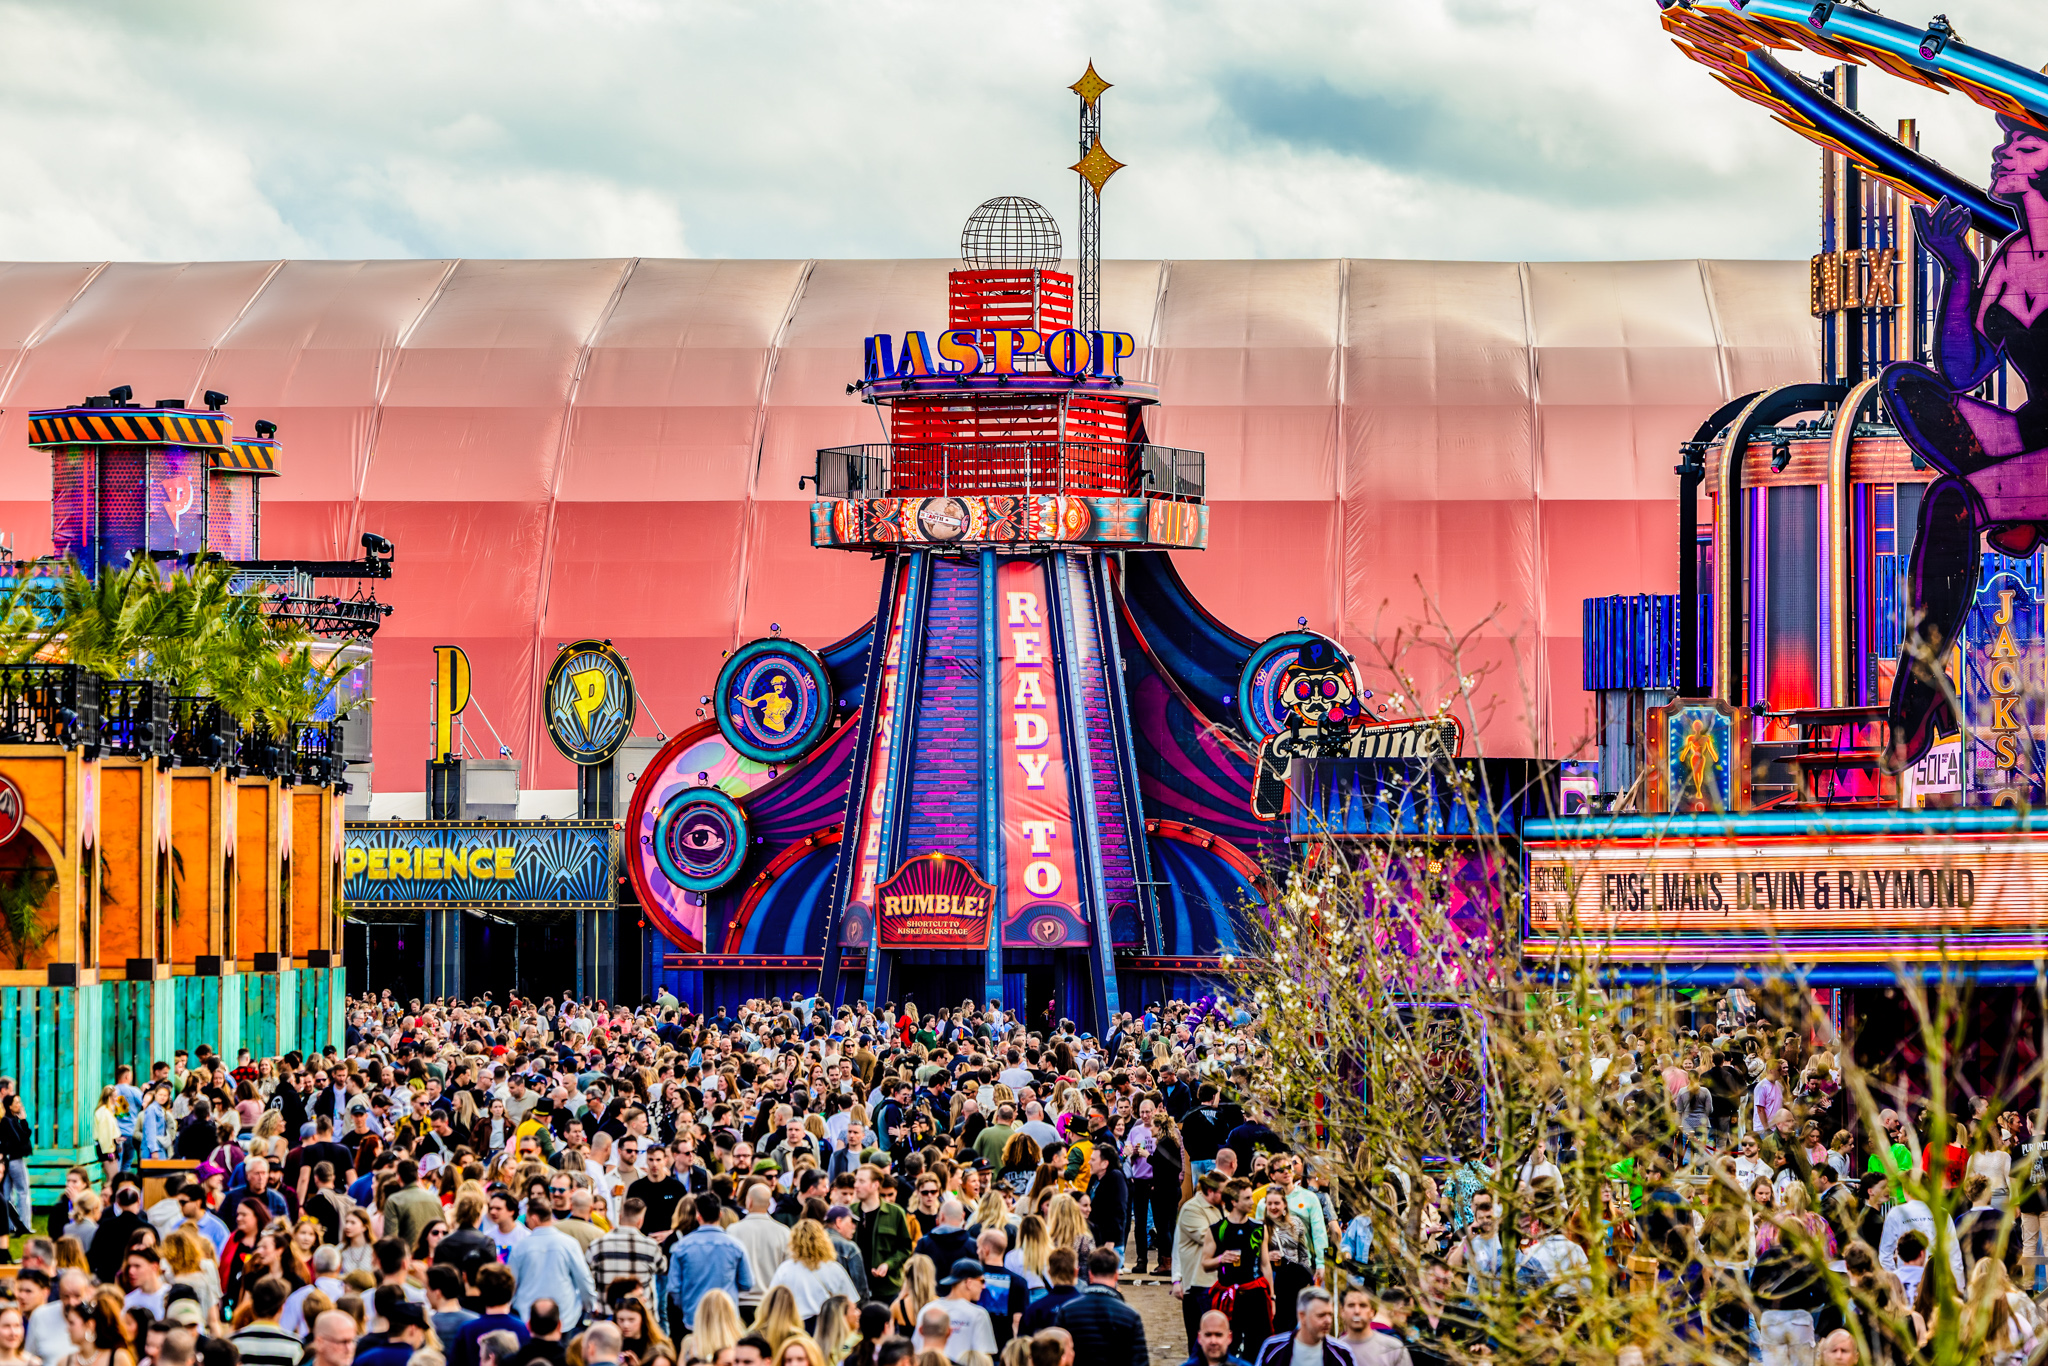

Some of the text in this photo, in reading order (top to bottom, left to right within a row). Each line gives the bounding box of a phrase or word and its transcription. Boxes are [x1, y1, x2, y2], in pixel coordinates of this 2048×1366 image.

[1991, 589, 2021, 771] JACKS
[570, 668, 606, 742] P
[1006, 591, 1062, 898] READY TO
[345, 847, 516, 880] PERIENCE
[884, 894, 985, 920] RUMBLE!
[1737, 871, 1804, 910] DEVIN
[1813, 871, 1830, 910] &
[1839, 868, 1975, 909] RAYMOND
[906, 920, 948, 928] SHORTCUT
